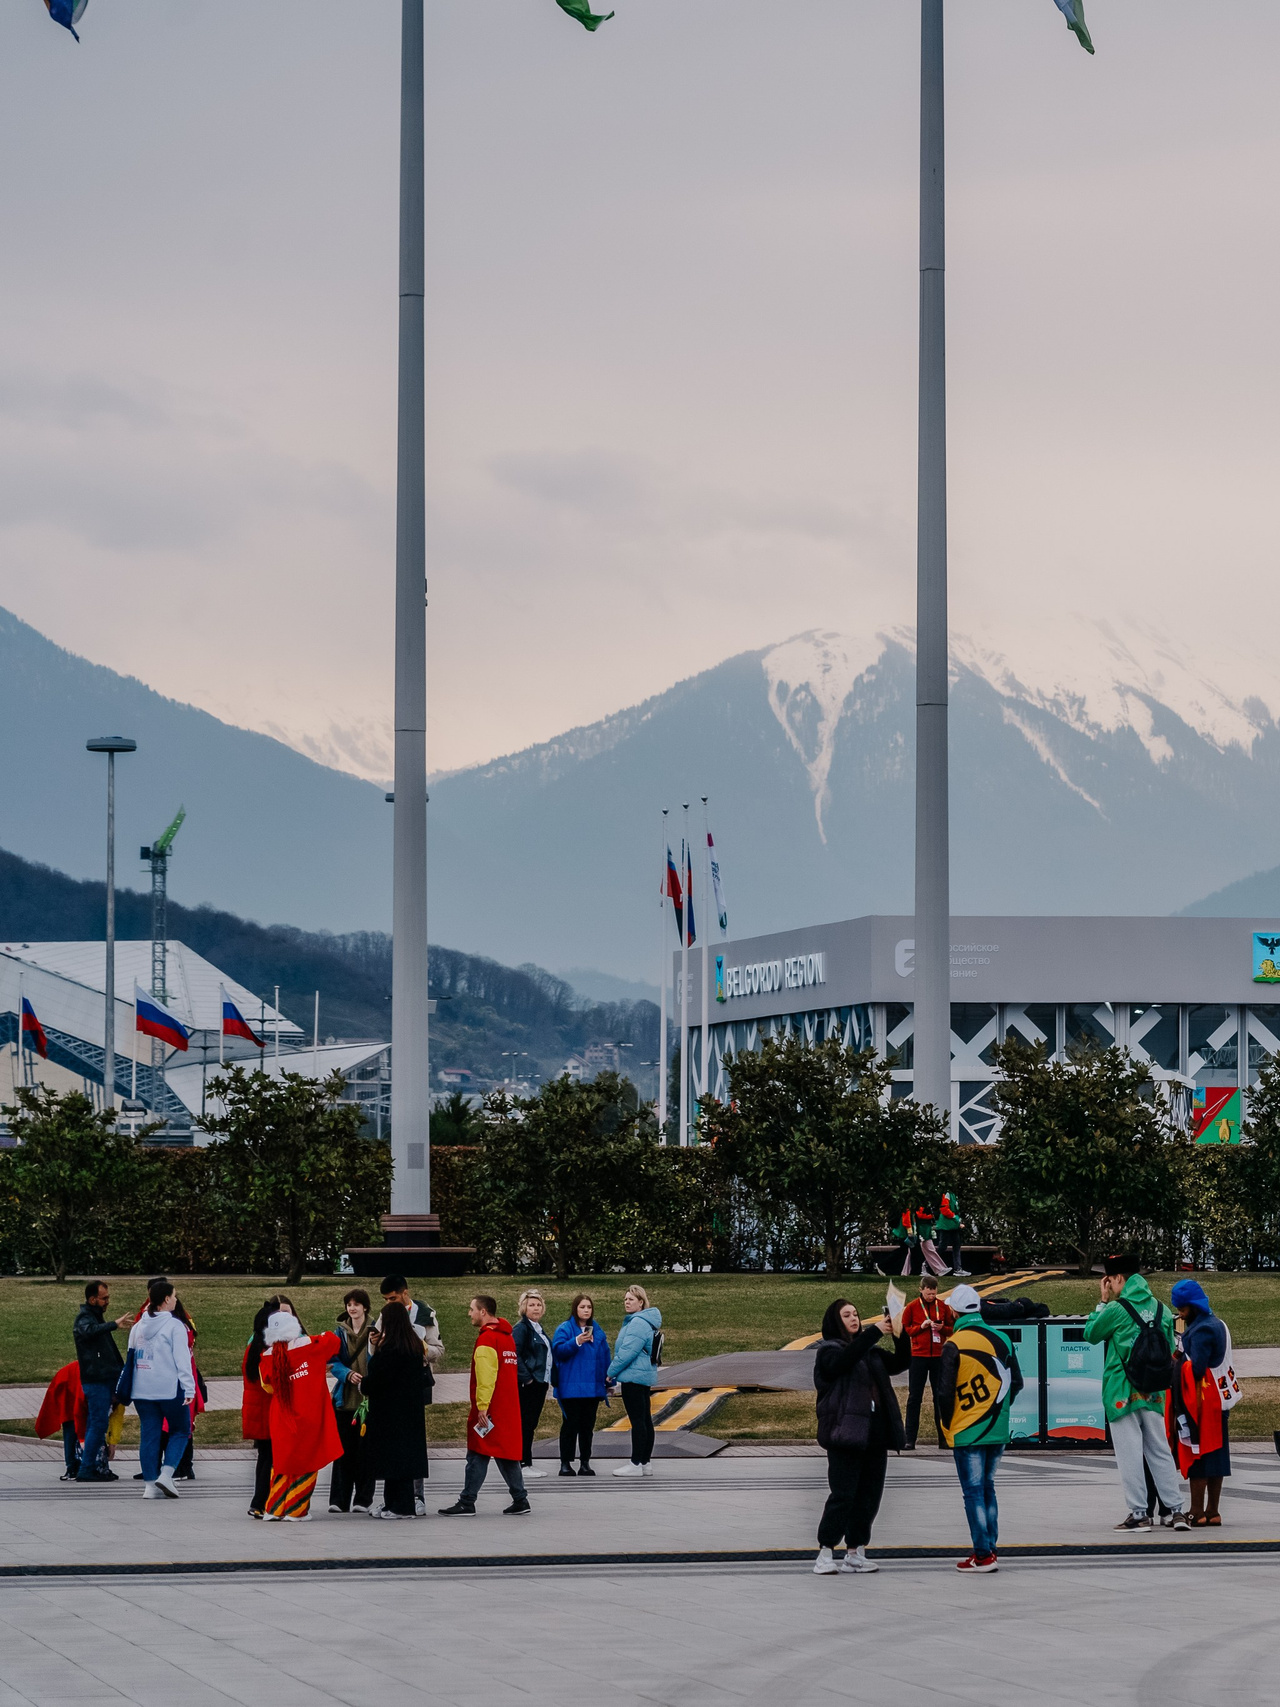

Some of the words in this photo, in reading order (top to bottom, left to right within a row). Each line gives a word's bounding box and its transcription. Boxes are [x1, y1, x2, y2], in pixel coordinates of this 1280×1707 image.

[726, 961, 782, 998] BELGOROD
[784, 952, 826, 989] REGION
[957, 1373, 991, 1411] 58
